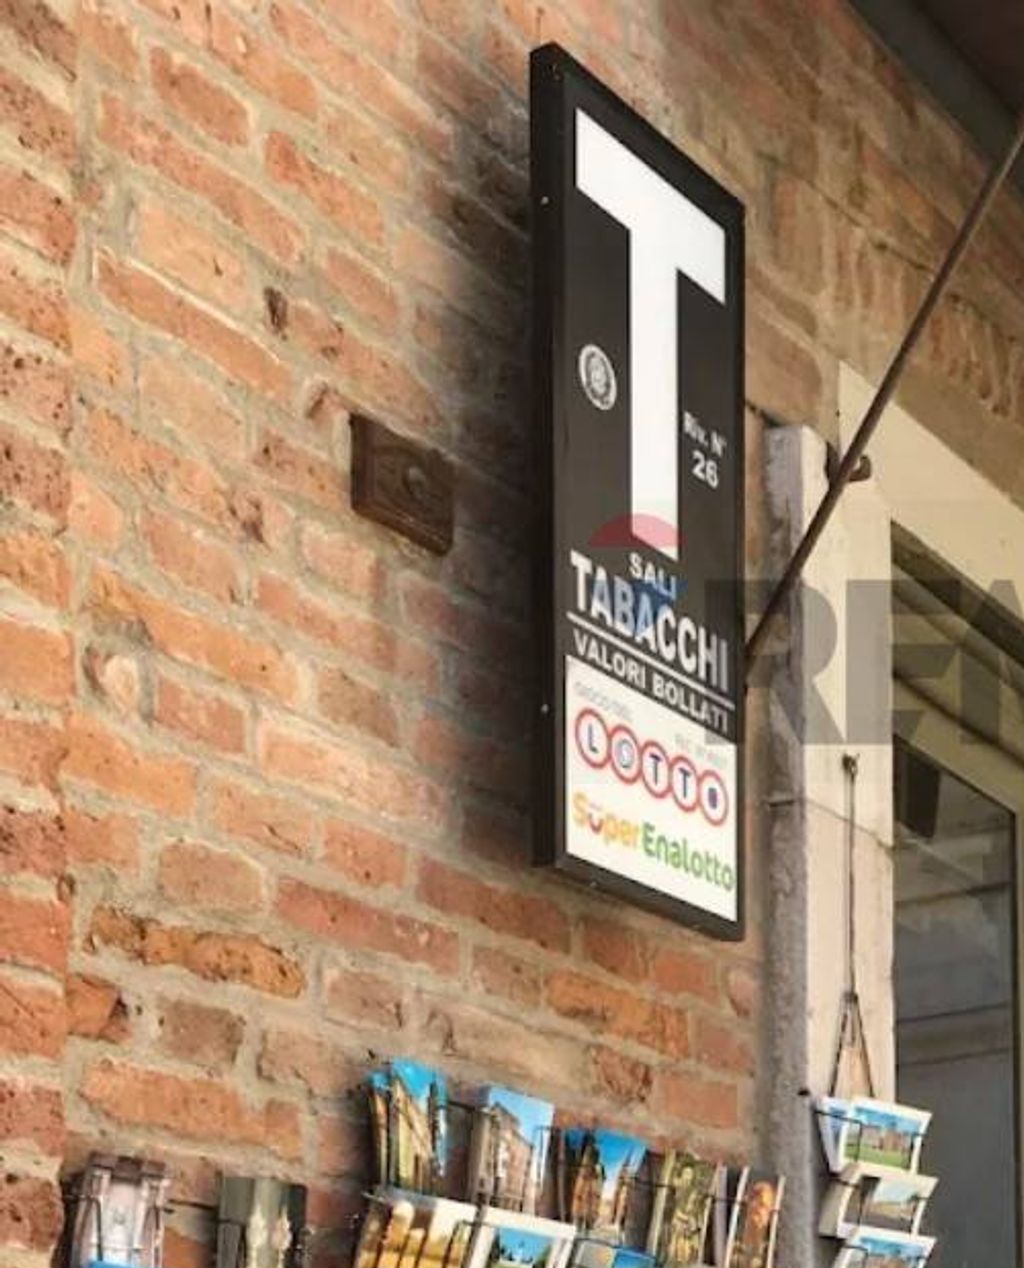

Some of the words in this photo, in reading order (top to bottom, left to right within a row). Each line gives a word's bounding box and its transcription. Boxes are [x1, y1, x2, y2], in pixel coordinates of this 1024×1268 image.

[575, 107, 726, 561] T
[691, 450, 720, 489] 26
[569, 549, 729, 693] TABACCHI
[628, 551, 678, 600] SALI
[572, 627, 647, 691] VALORI
[651, 669, 729, 735] BOLLATI
[575, 708, 730, 827] LOTTO
